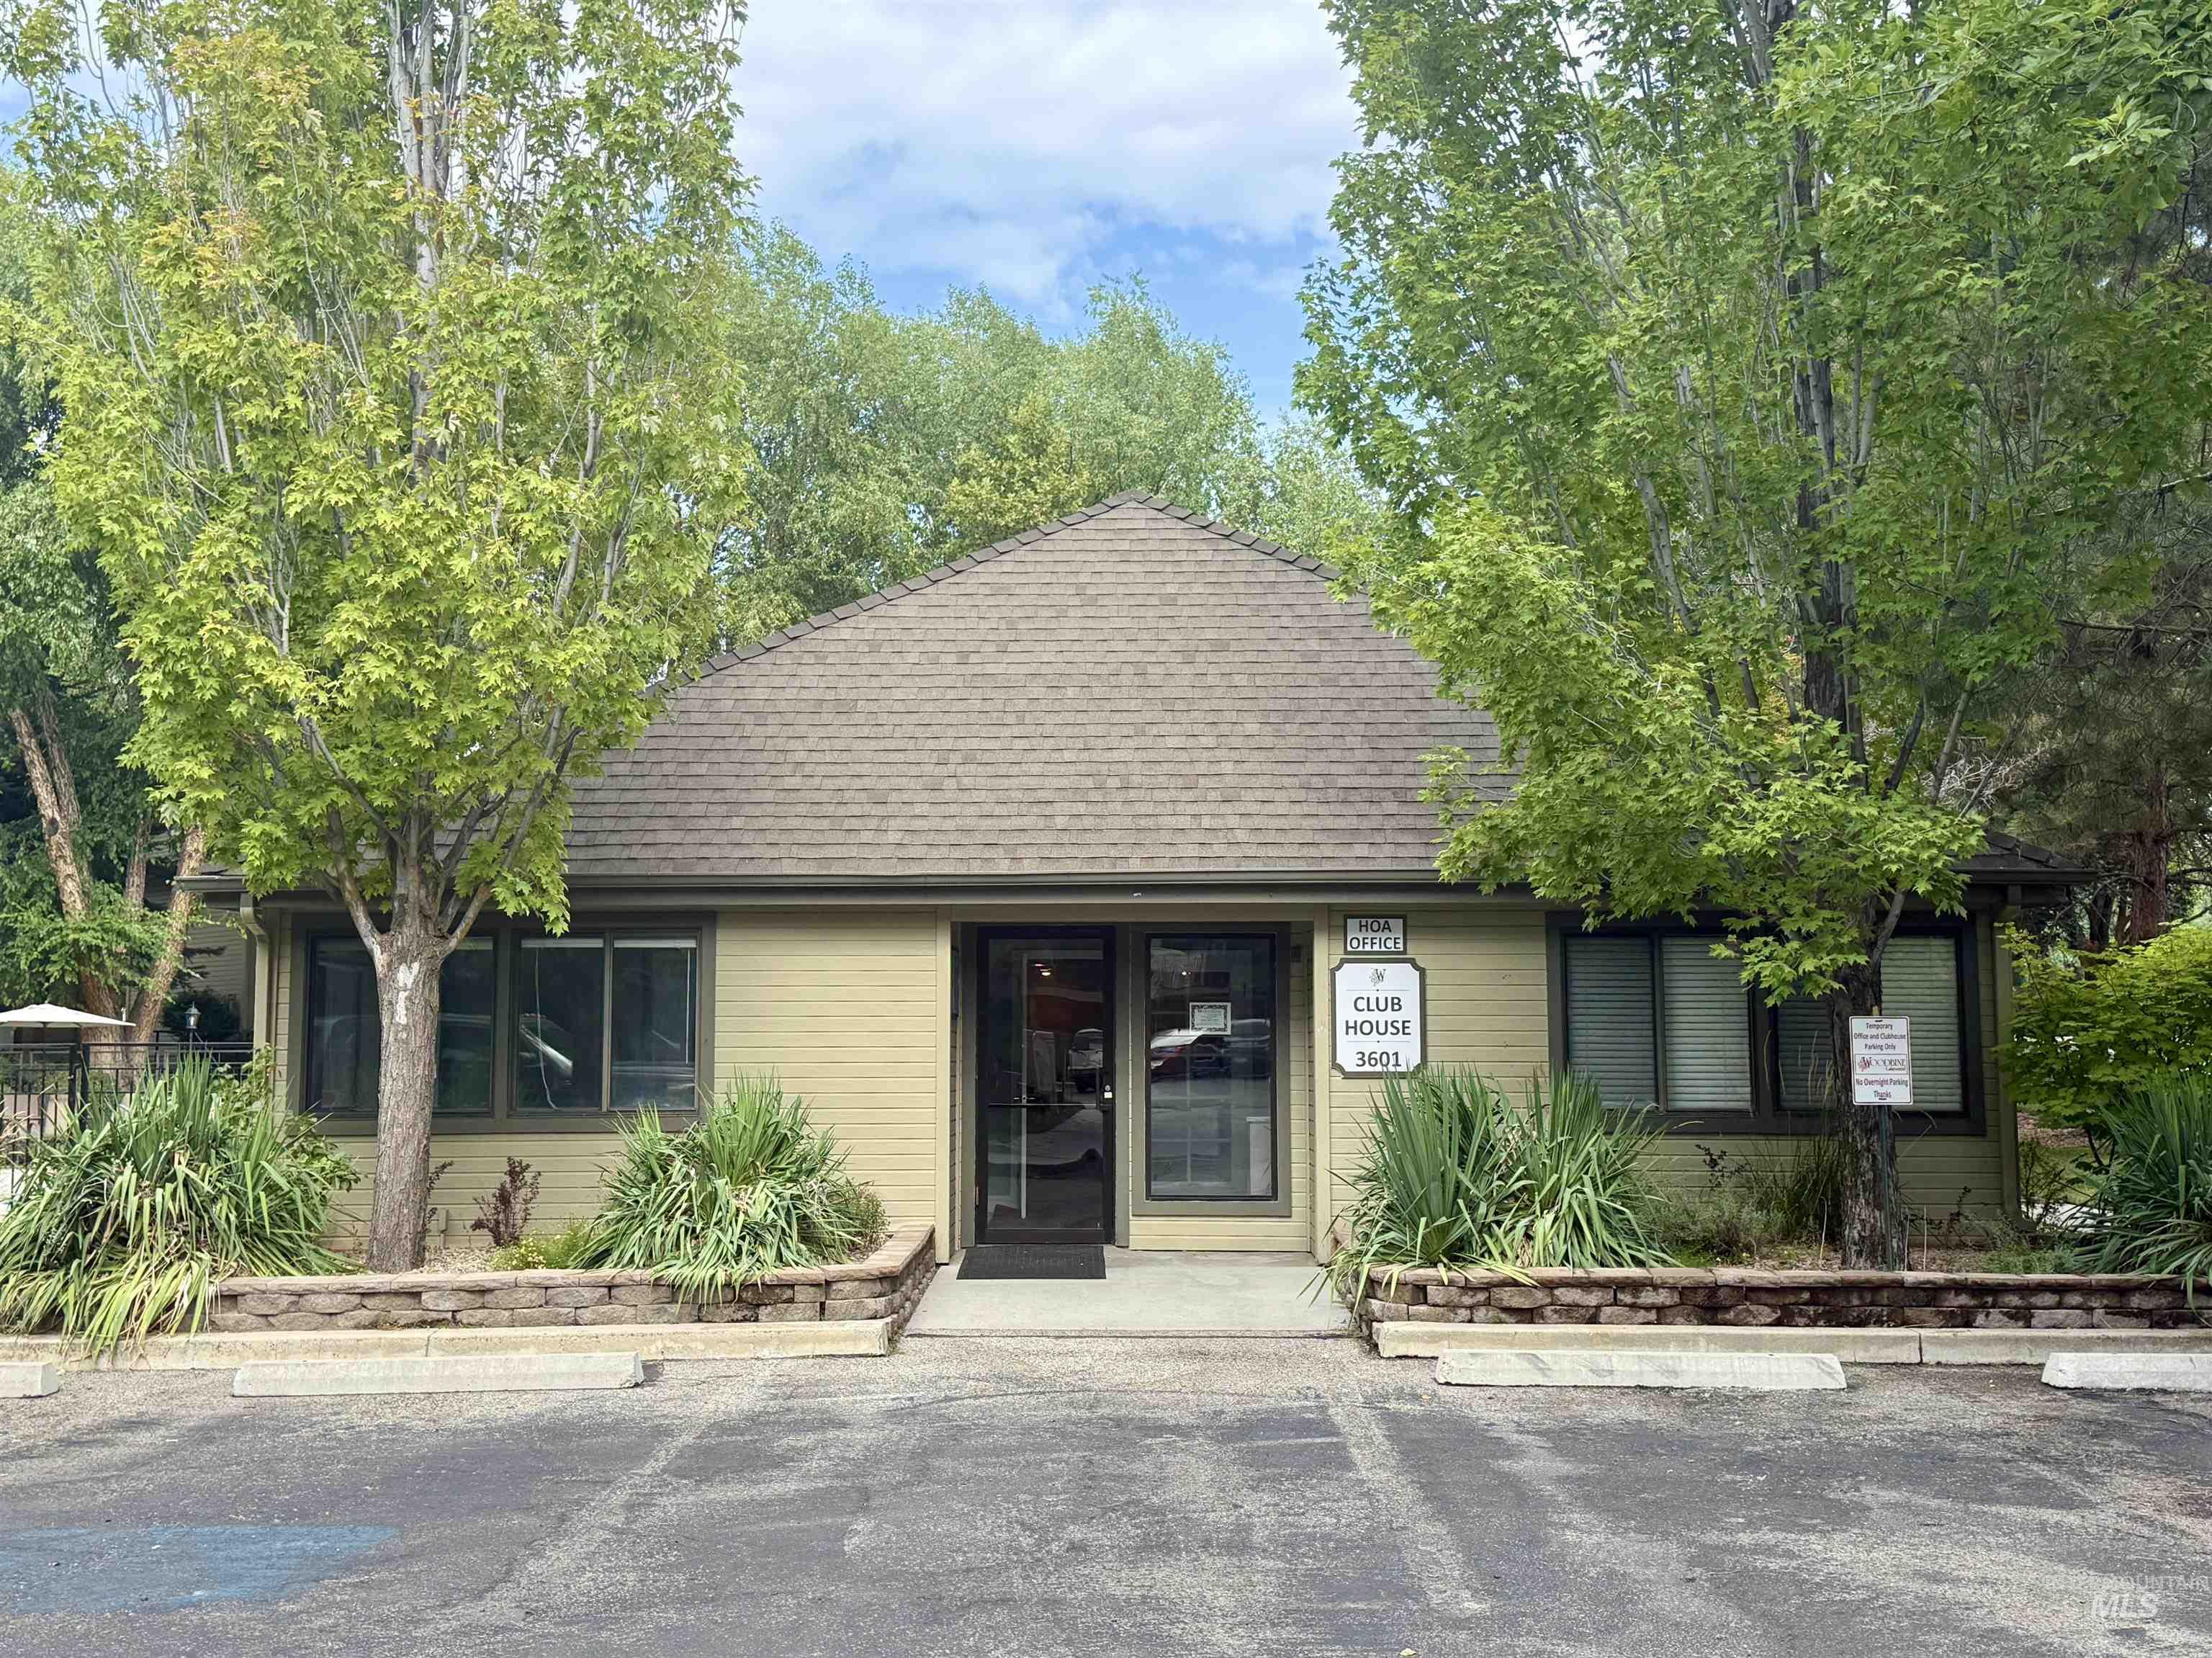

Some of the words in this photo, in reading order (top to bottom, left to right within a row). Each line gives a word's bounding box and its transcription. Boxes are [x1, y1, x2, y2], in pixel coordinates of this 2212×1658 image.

[1359, 920, 1392, 933] HOA
[1349, 937, 1401, 949] OFFICE
[1353, 996, 1403, 1012] CLUB
[1345, 1020, 1411, 1036] HOUSE
[1355, 1052, 1401, 1067] 3601
[1864, 1078, 1889, 1087] Overnight
[1889, 1078, 1908, 1088] Parking
